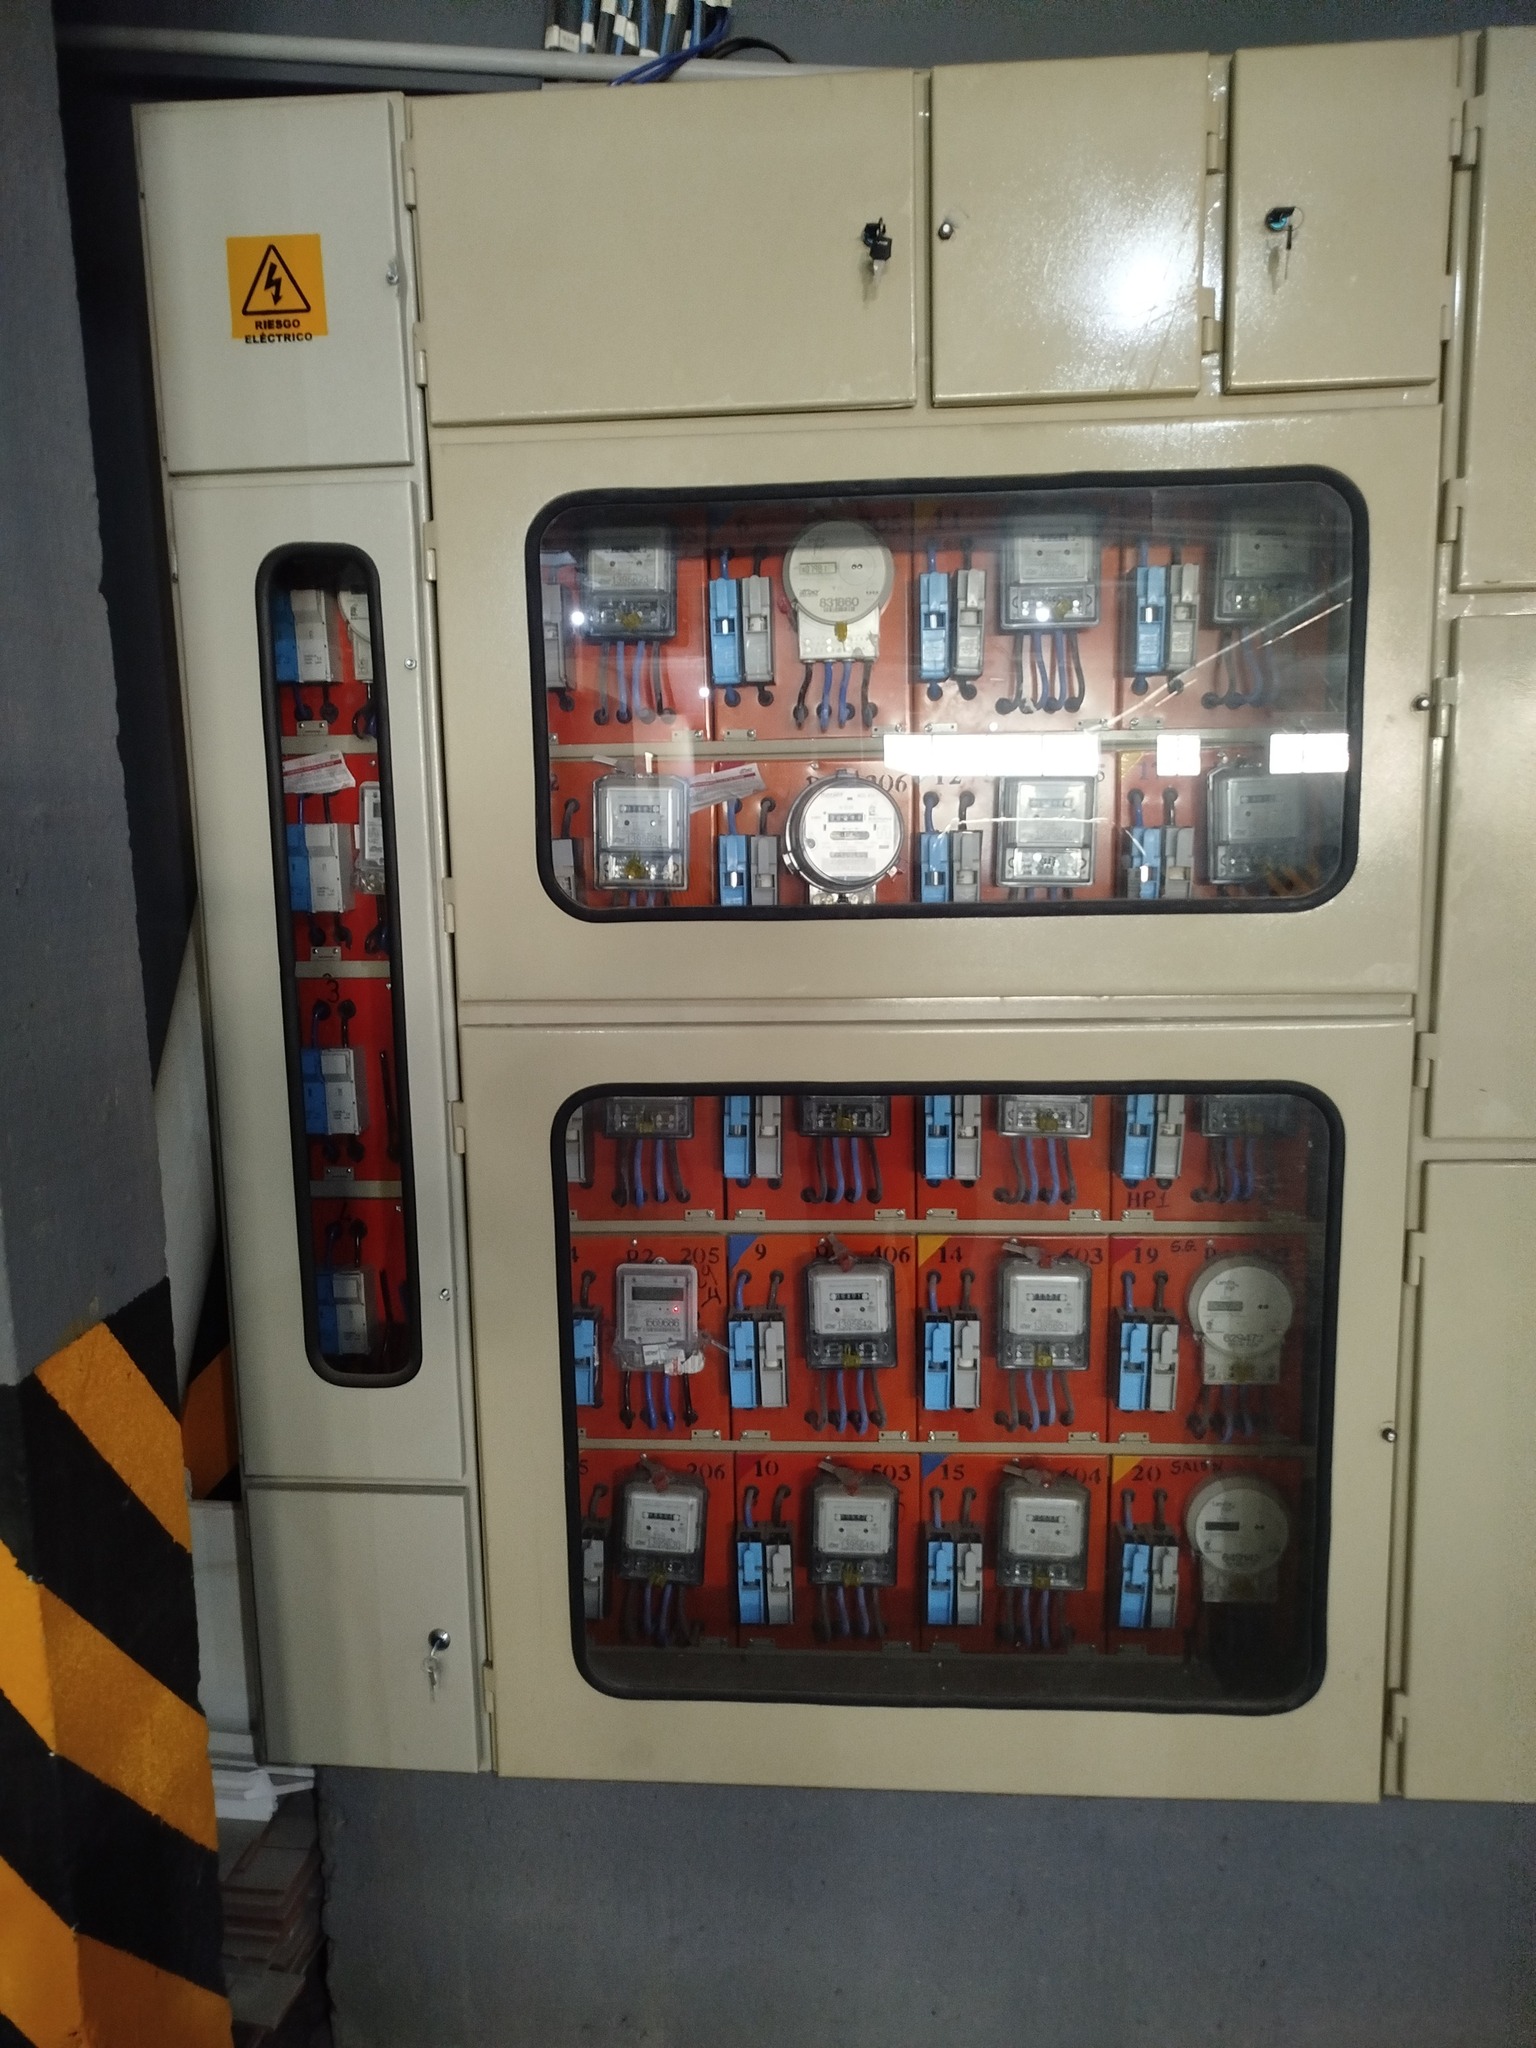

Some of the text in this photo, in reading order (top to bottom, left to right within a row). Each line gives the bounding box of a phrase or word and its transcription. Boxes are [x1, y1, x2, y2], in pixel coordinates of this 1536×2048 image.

[255, 319, 301, 330] RIESGO
[244, 332, 313, 344] ELÉCTRICO
[680, 1247, 720, 1264] 205
[755, 1243, 767, 1261] 9
[938, 1246, 962, 1263] 14
[1134, 1246, 1158, 1264] 19
[754, 1459, 780, 1478] 10
[940, 1463, 966, 1481] 15
[1132, 1464, 1162, 1482] 20
